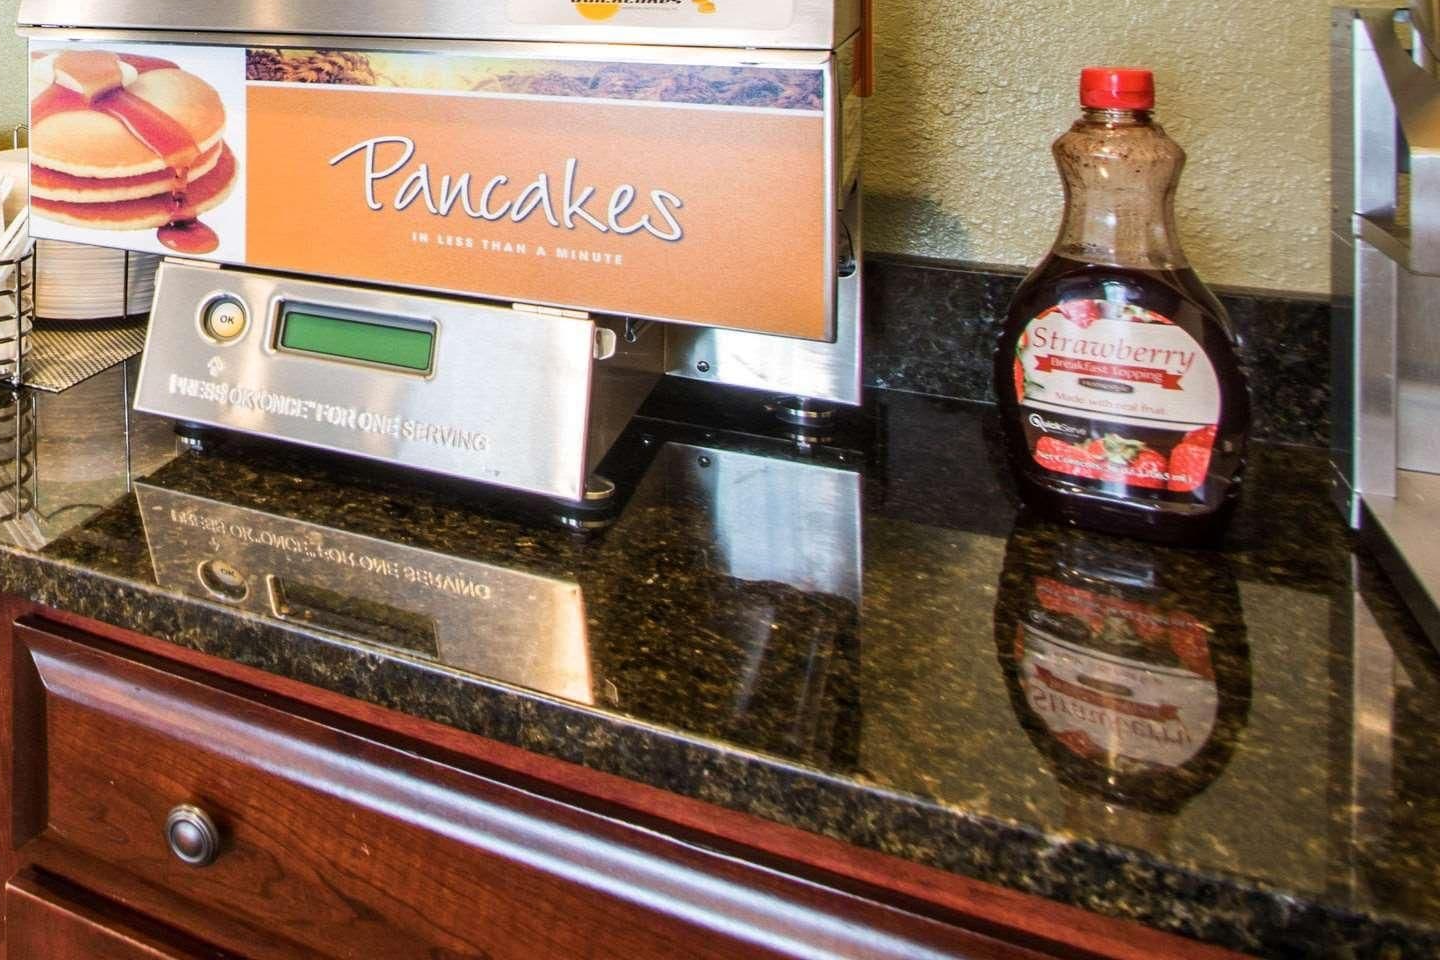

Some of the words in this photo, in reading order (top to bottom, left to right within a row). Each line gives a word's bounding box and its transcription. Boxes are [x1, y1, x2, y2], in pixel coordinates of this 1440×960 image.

[328, 135, 684, 241] Pancakes
[412, 232, 428, 243] IN
[437, 234, 474, 249] LESS
[482, 239, 527, 255] THAN
[535, 245, 547, 257] A
[555, 247, 624, 265] MINUTE
[219, 313, 235, 325] OK
[1032, 326, 1196, 373] Strawberry
[1049, 355, 1110, 374] Breakfast
[1111, 364, 1165, 384] Topping
[168, 373, 229, 405] PRESS
[315, 401, 357, 430] FOR
[357, 411, 400, 438] ONE
[400, 418, 488, 451] SERVING
